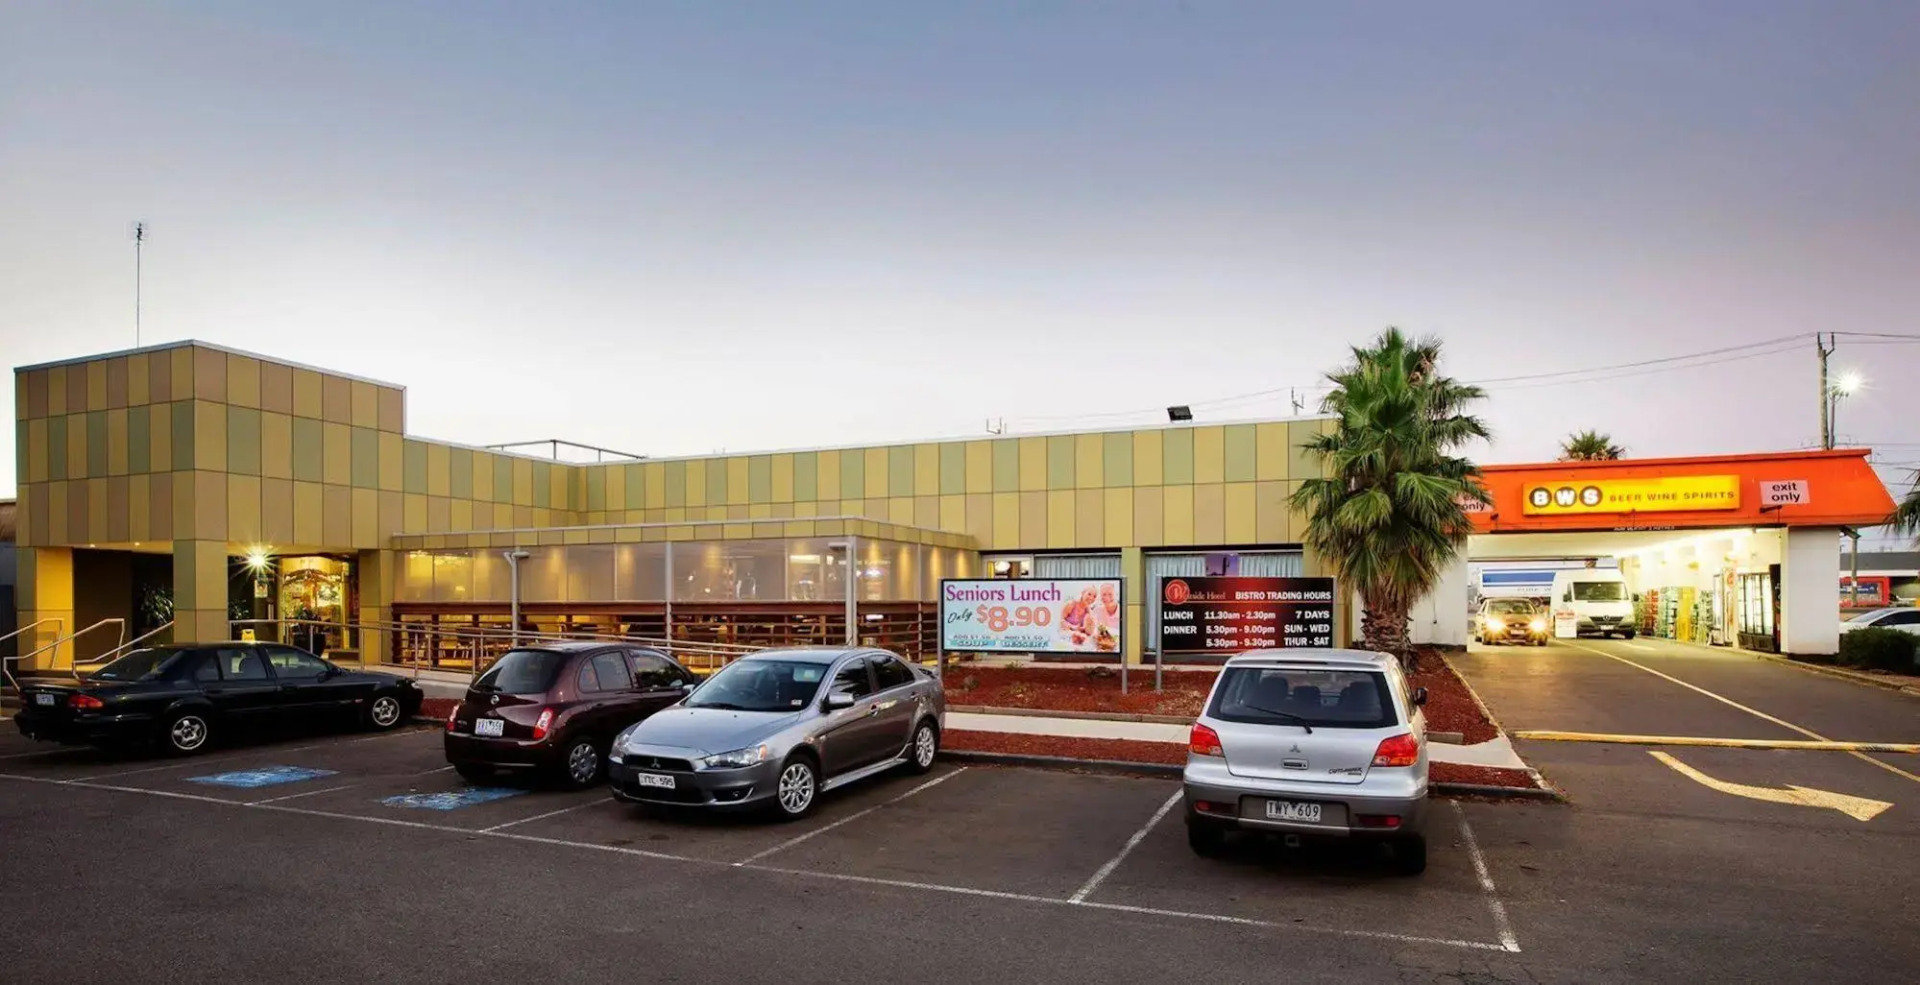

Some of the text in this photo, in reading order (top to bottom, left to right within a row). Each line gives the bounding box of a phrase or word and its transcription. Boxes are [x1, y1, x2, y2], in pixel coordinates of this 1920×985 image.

[1772, 481, 1797, 491] exit
[1531, 487, 1601, 507] BWS
[1610, 490, 1735, 503] BEER WINE SPIRITS
[1771, 491, 1801, 503] only
[1462, 501, 1485, 511] only
[946, 582, 1061, 601] Seniors Lunch
[1235, 591, 1332, 600] BISTRO TRADING HOURS
[947, 608, 973, 624] Only
[976, 604, 1052, 632] $8.90
[1164, 611, 1194, 620] LUNCH
[1204, 611, 1240, 620] 11.30am
[1246, 611, 1276, 621] 2.30pm
[1295, 611, 1301, 619] 7
[1304, 610, 1330, 619] DAYS
[1164, 626, 1197, 635] DINNER
[1206, 626, 1238, 635] 5.30pm
[1244, 626, 1275, 635] 9.00pm
[1284, 624, 1303, 633] SUN
[1309, 624, 1330, 633] WED
[1206, 638, 1238, 648] 5.30pm
[1244, 638, 1275, 648] 9.30pm
[1284, 637, 1307, 646] THUR
[1313, 637, 1329, 646] SAT
[1268, 801, 1319, 817] TWY 609
